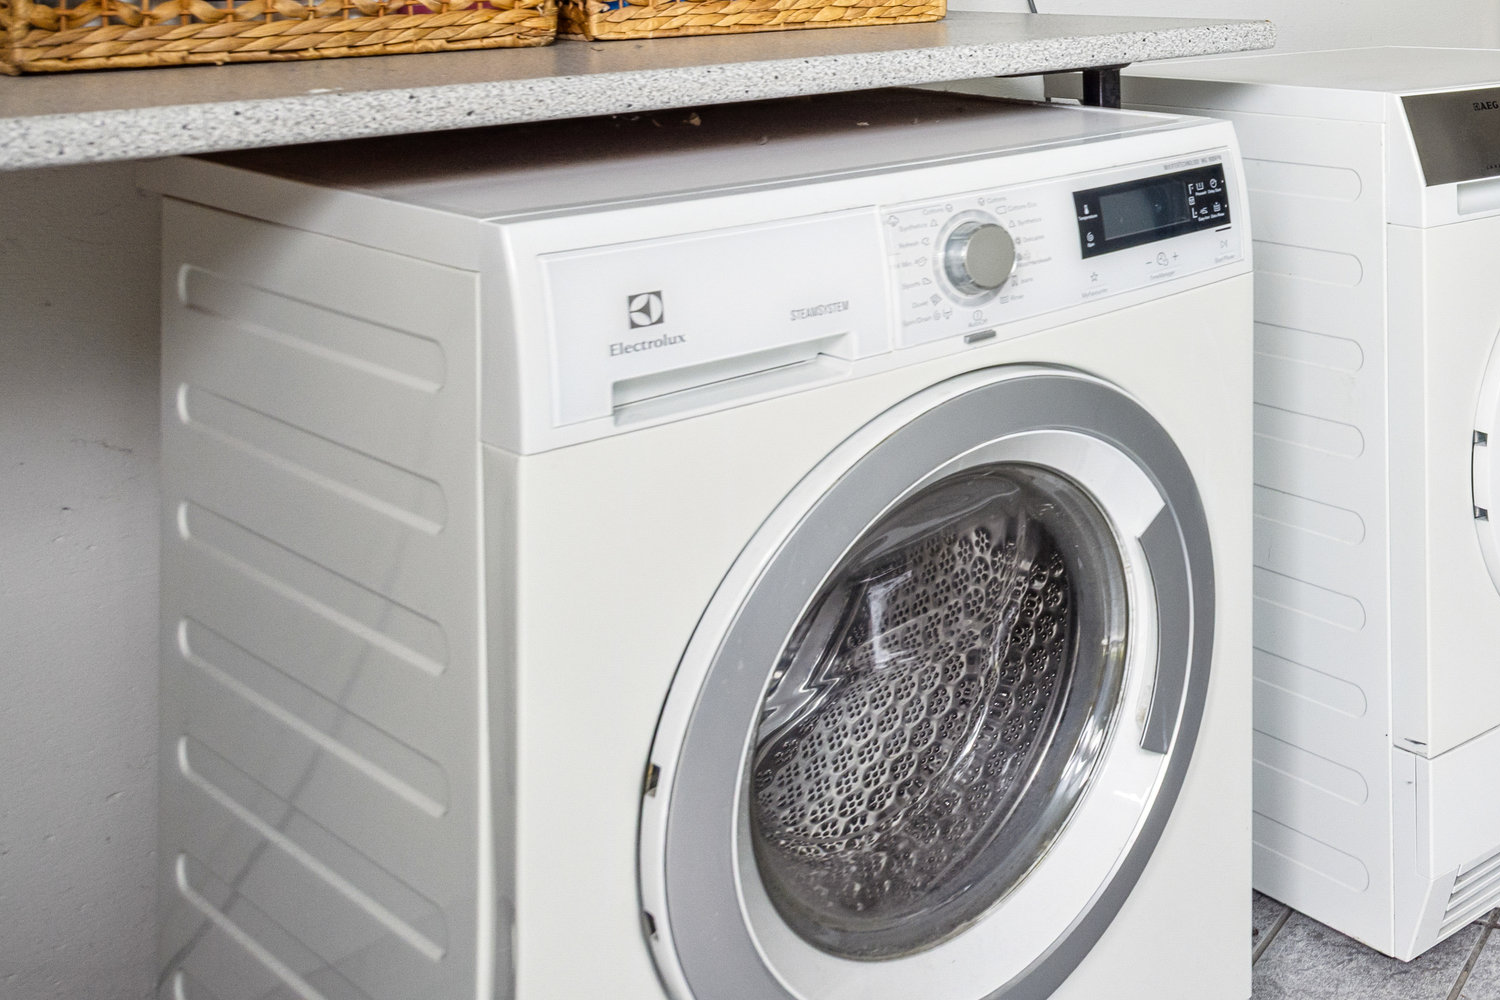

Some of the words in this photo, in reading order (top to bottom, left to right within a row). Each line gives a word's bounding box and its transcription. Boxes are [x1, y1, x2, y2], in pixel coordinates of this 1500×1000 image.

[1480, 100, 1499, 111] AEG
[791, 300, 849, 321] STEAMSYSTEM
[609, 334, 686, 357] Electrolux
